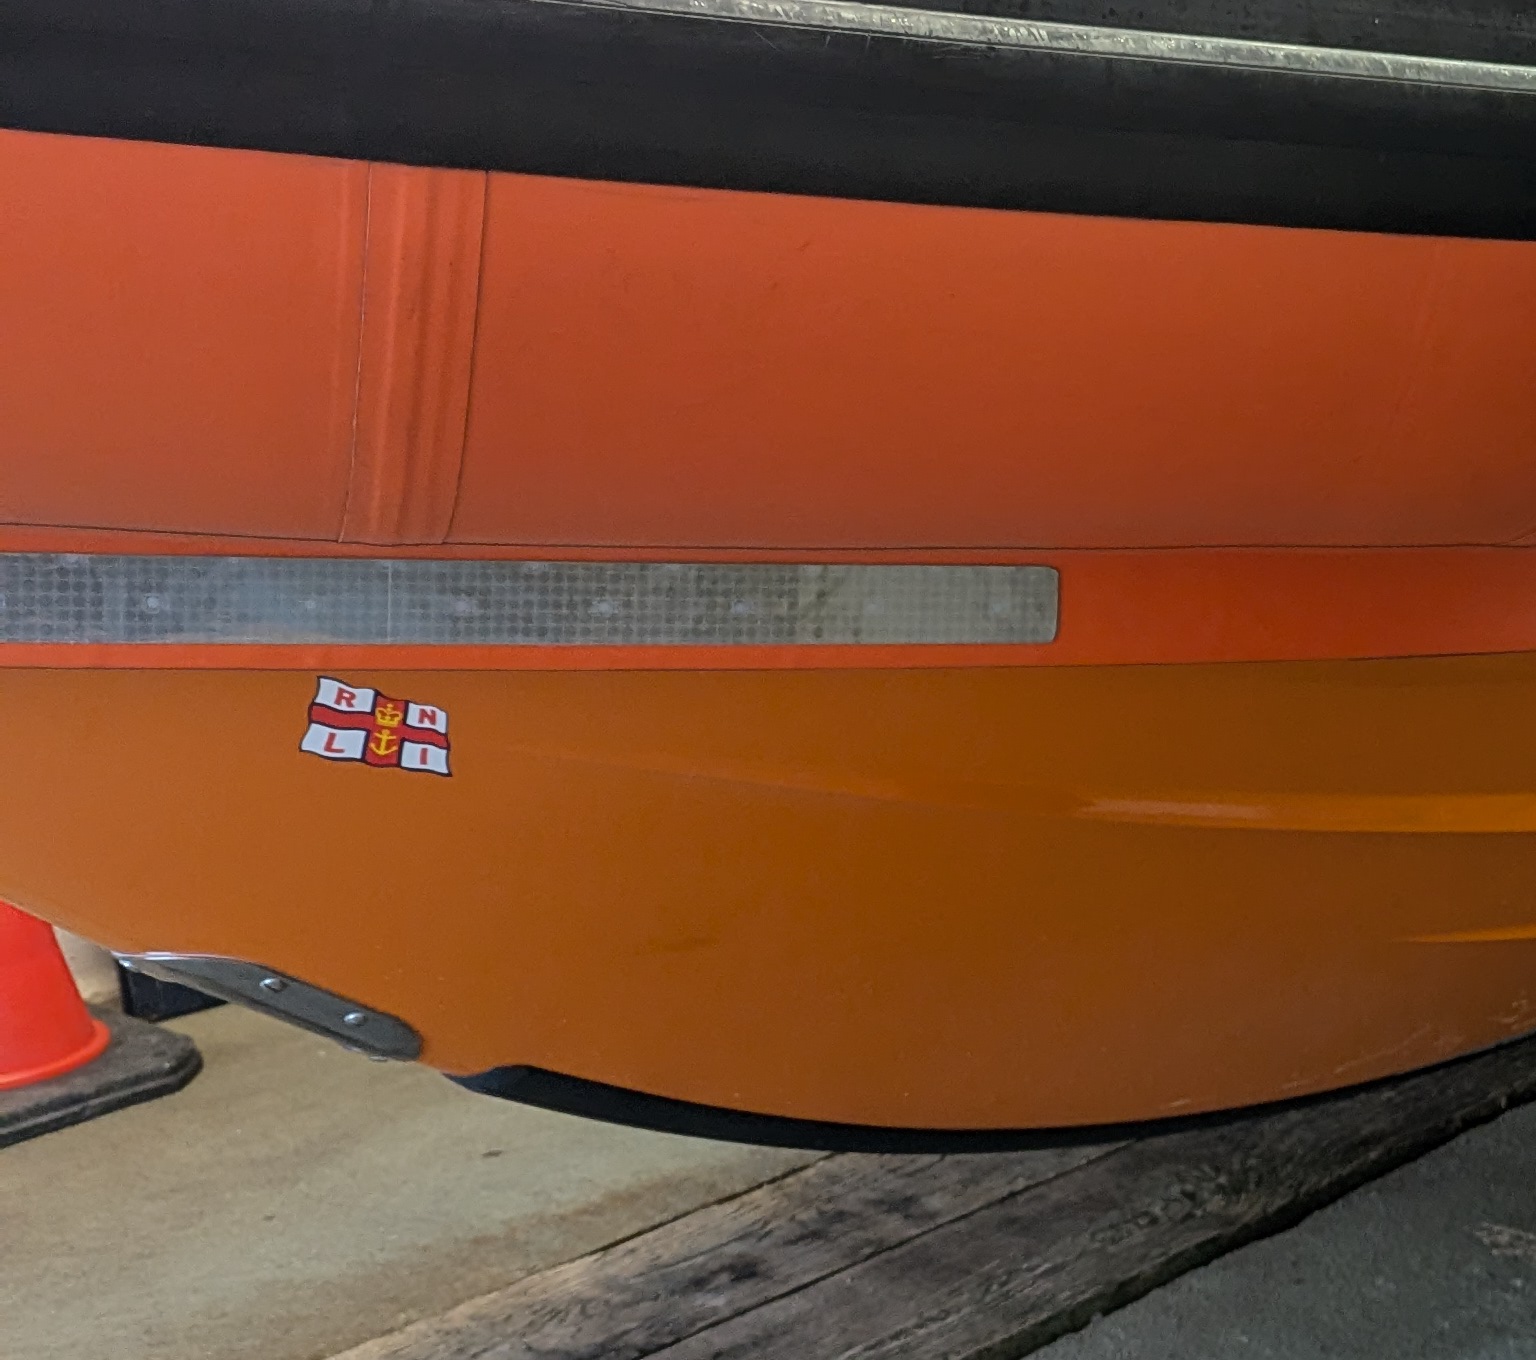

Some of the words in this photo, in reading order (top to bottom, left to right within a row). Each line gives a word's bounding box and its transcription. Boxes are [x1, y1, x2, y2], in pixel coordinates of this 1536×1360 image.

[334, 688, 356, 707] R
[418, 709, 436, 726] N
[324, 733, 344, 753] L
